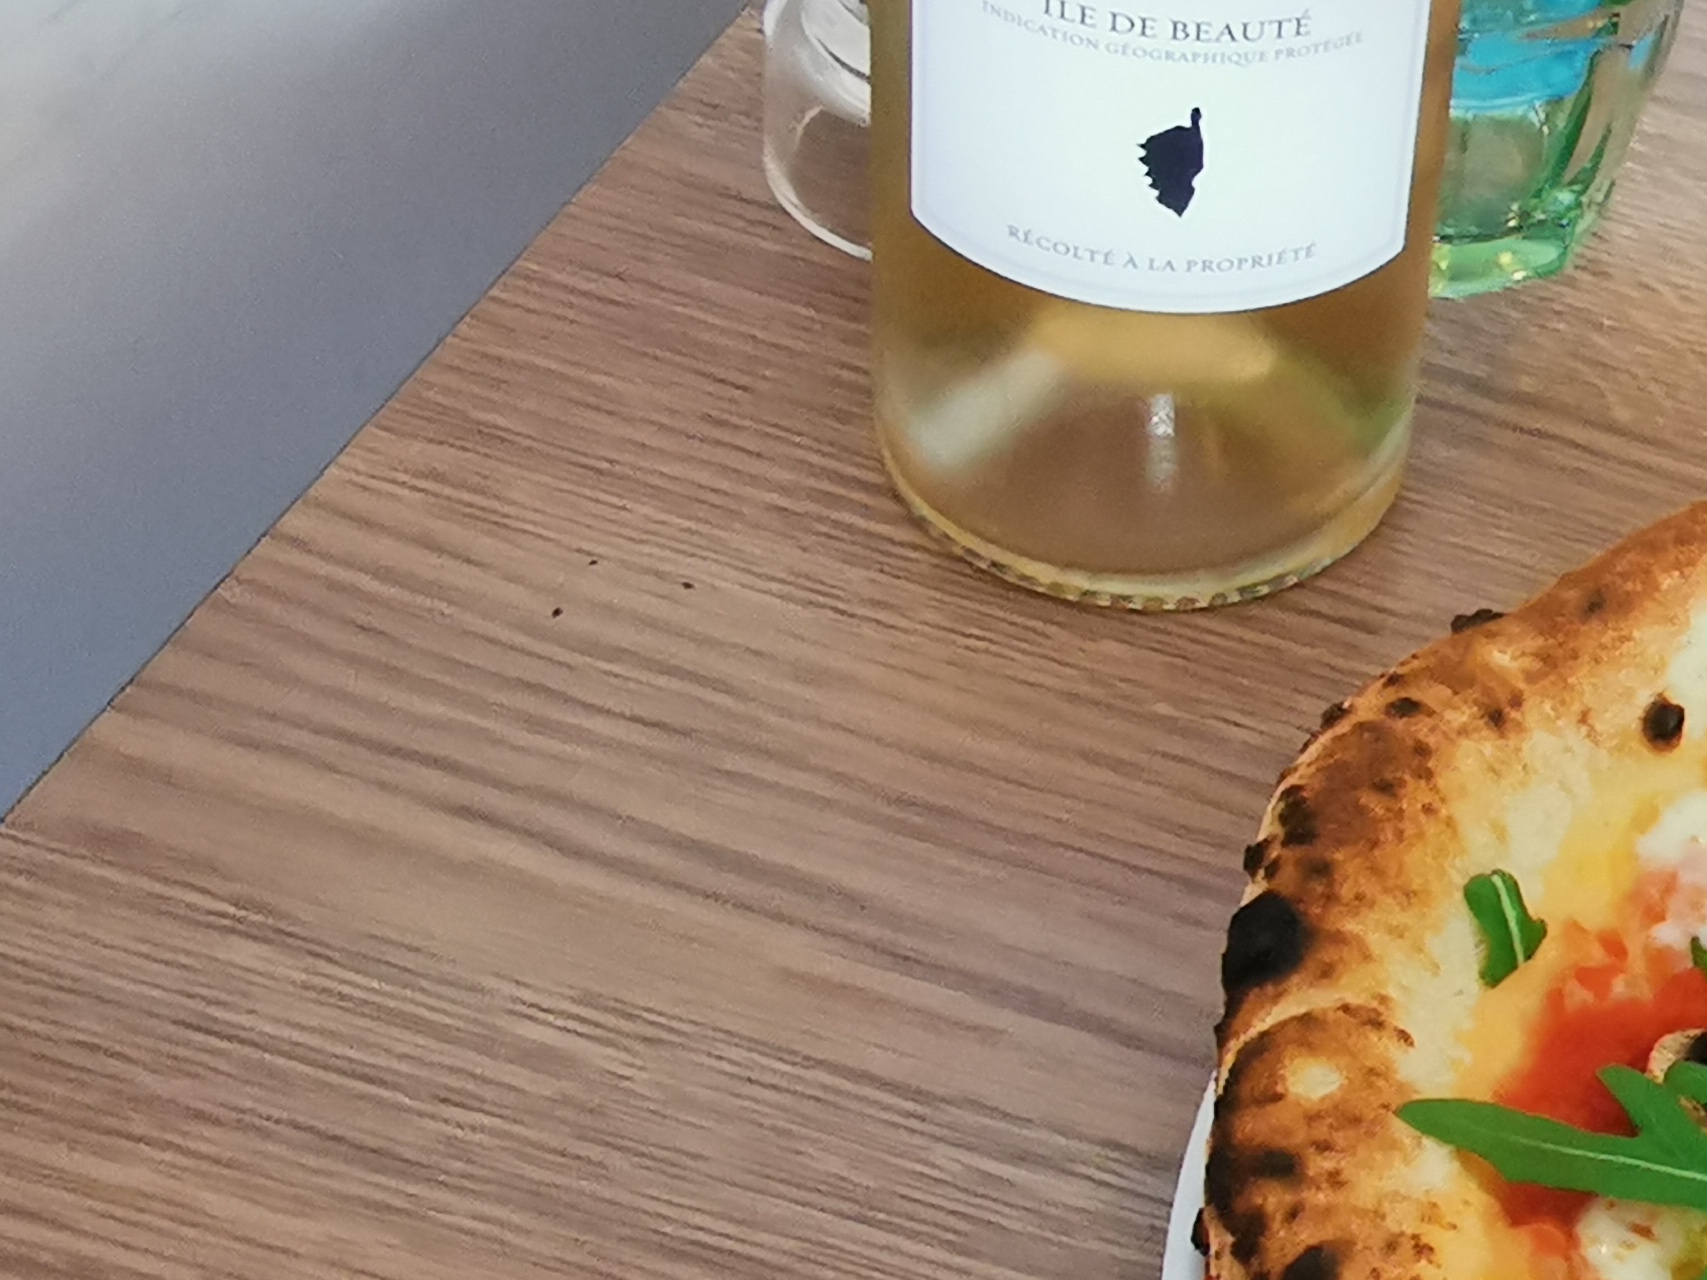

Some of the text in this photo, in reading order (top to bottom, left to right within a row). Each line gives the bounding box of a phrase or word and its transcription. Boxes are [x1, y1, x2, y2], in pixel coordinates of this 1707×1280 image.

[982, 0, 1099, 51] INDICATION
[1109, 11, 1157, 38] DE
[1170, 8, 1312, 43] BEAUTÉ
[1006, 224, 1318, 273] RÉCOLTÉ À LA PROPRIÉTÉ
